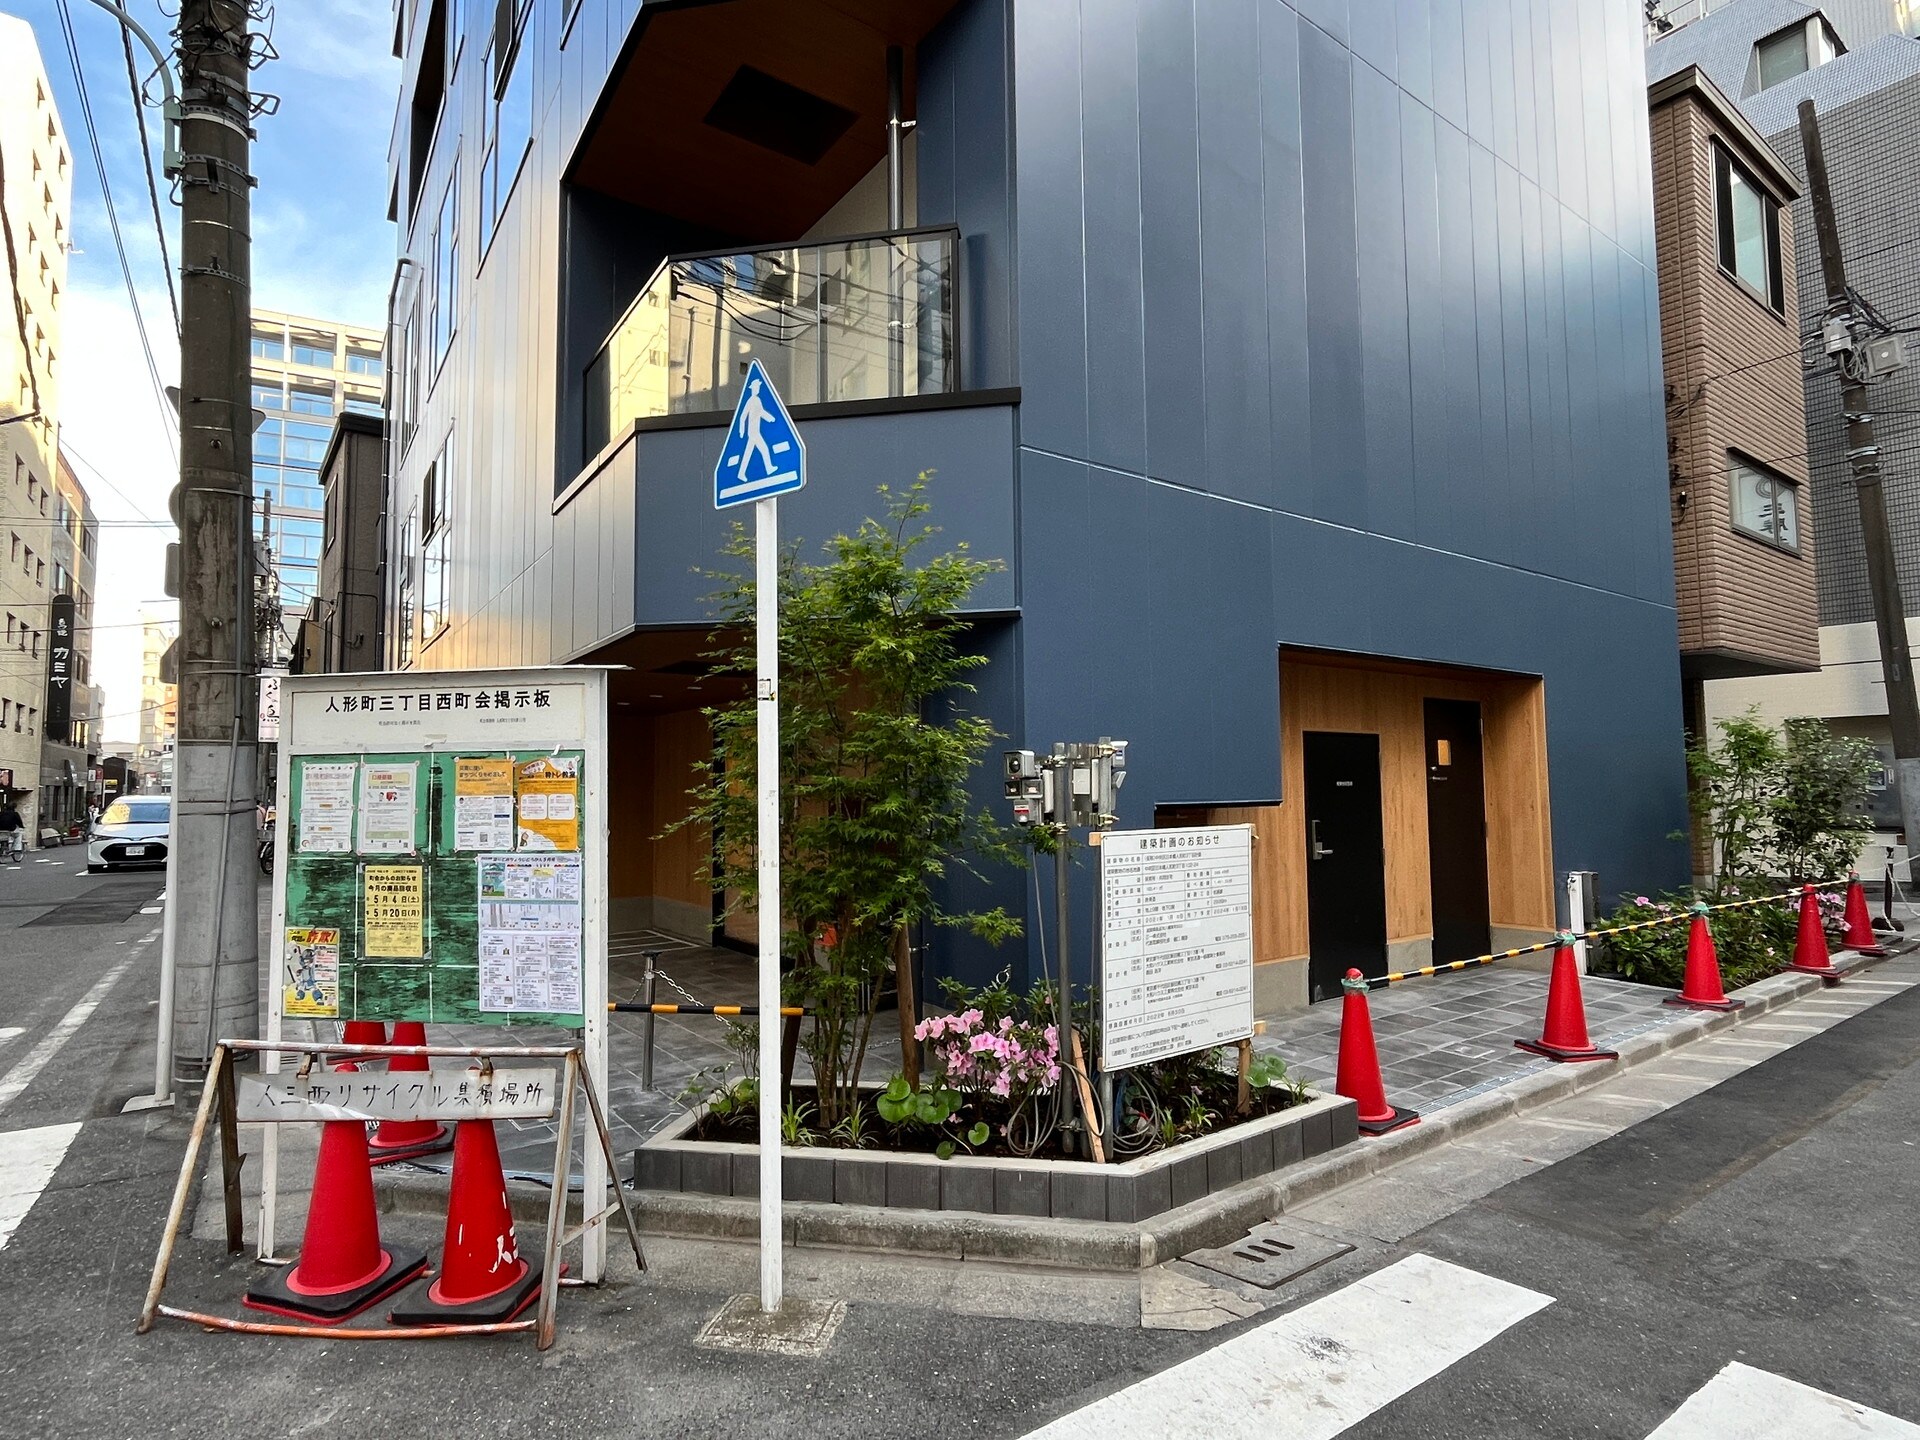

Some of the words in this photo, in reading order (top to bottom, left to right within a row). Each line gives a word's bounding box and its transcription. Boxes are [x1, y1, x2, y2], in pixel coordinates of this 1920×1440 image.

[50, 646, 70, 689] カミヤ
[325, 688, 552, 712] 人形町三丁目西町会掲示板
[1140, 834, 1219, 850] 建築計画のお知らせ
